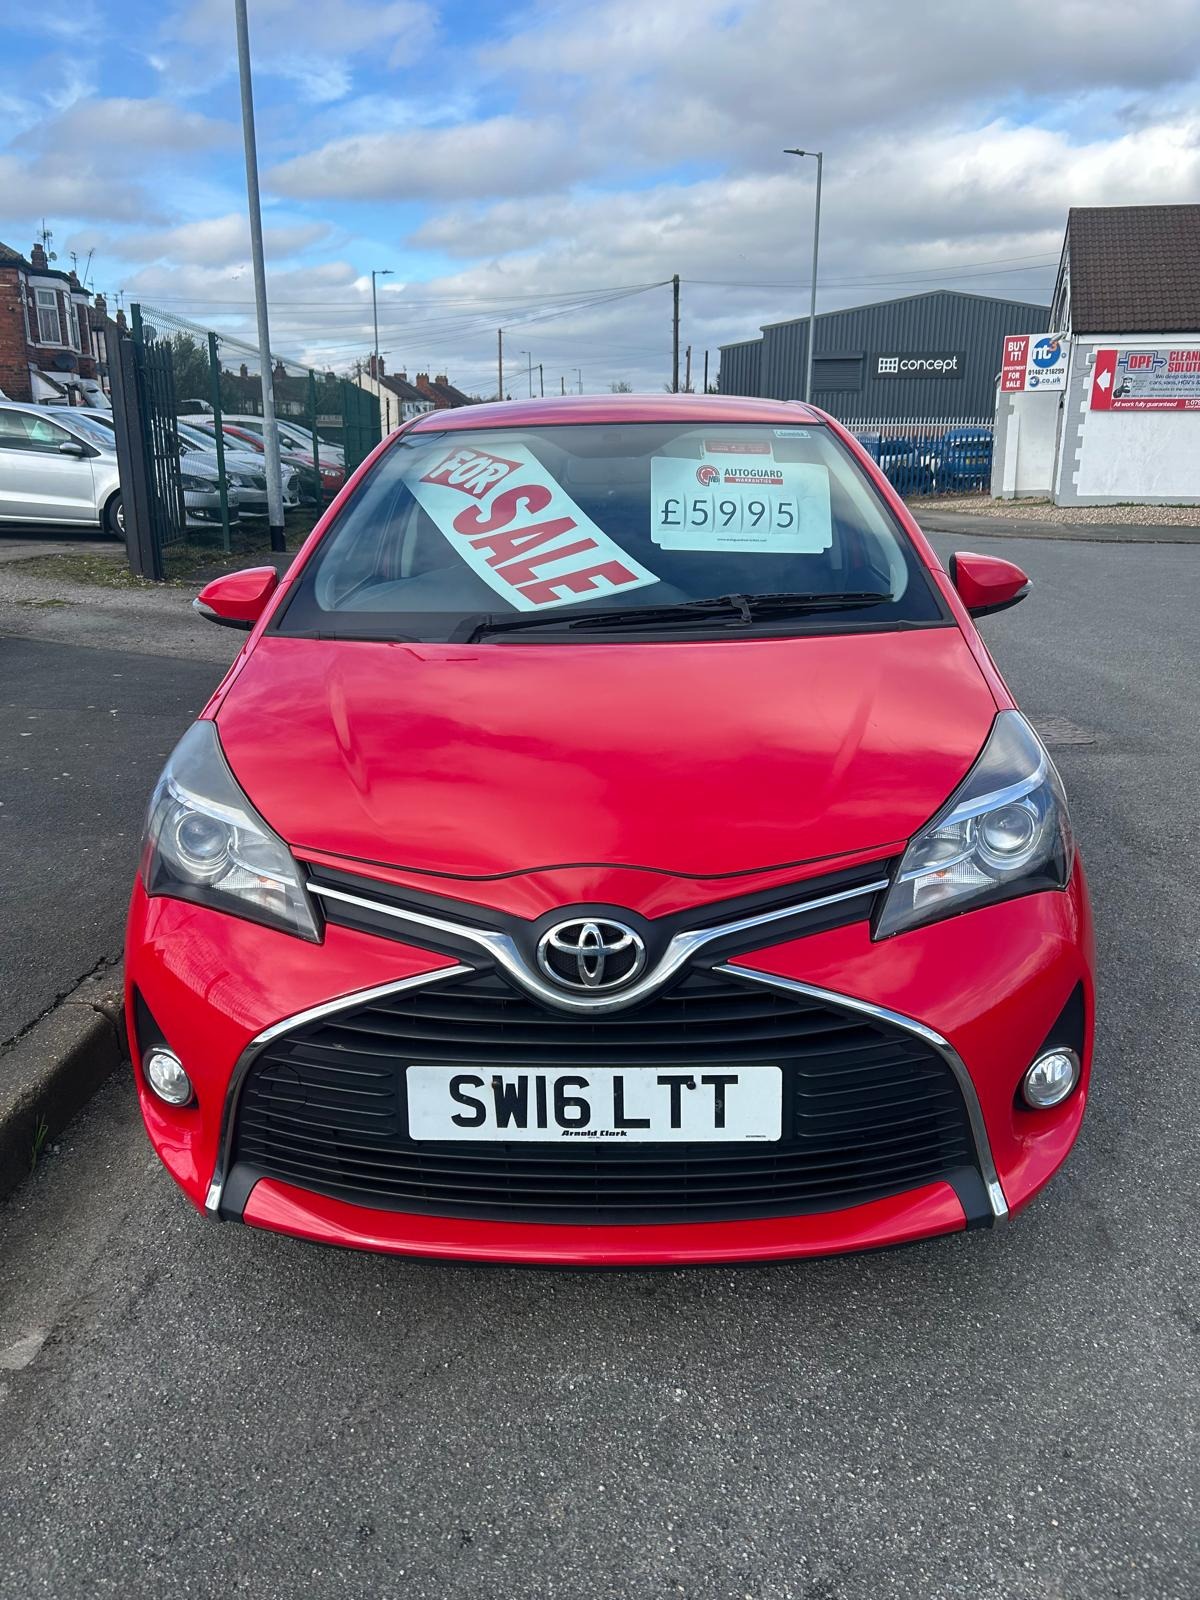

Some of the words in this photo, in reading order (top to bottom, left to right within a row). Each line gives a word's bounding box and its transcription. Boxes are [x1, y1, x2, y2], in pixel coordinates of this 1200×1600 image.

[1008, 341, 1026, 352] BUY
[900, 356, 958, 373] concept
[1010, 352, 1021, 361] IT!
[1129, 355, 1152, 368] DPF
[429, 450, 510, 495] FOR
[724, 467, 783, 478] AUTOGUARD
[661, 498, 794, 529] £5995
[453, 484, 640, 604] SALE
[449, 1074, 591, 1129] SW16
[613, 1074, 739, 1129] LTT
